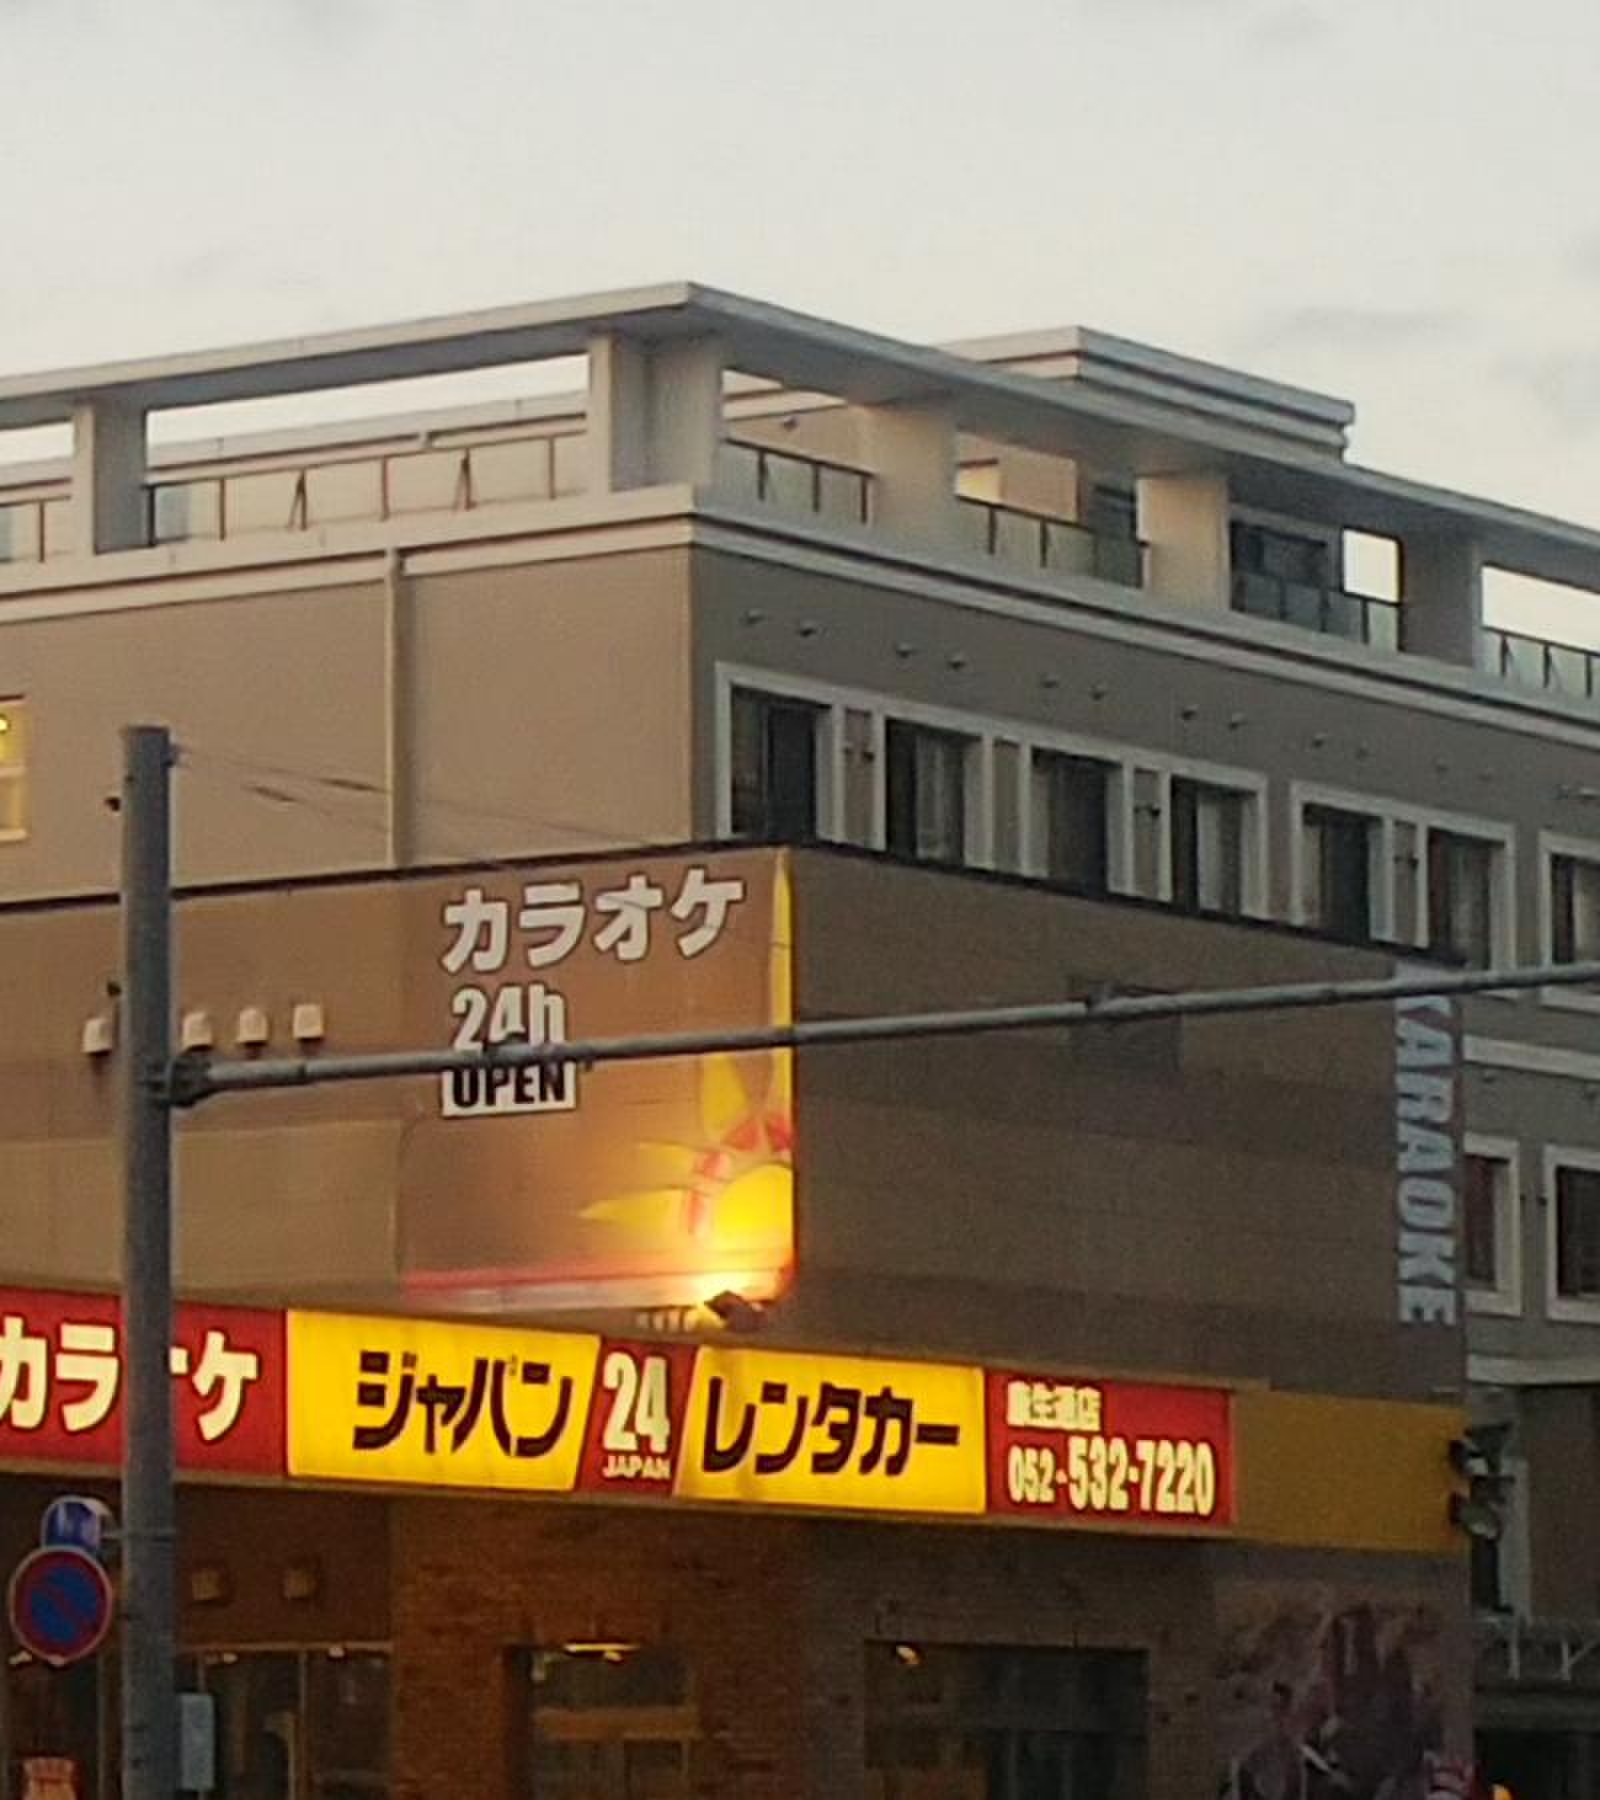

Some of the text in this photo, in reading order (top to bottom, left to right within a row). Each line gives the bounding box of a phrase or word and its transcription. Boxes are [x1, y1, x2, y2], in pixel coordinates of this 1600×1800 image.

[441, 868, 744, 973] カラオケ
[452, 984, 566, 1053] 24h
[453, 1060, 566, 1108] OPEN
[352, 1350, 960, 1477] ジャパン 24 レンタカー
[602, 1455, 671, 1479] JAPAN
